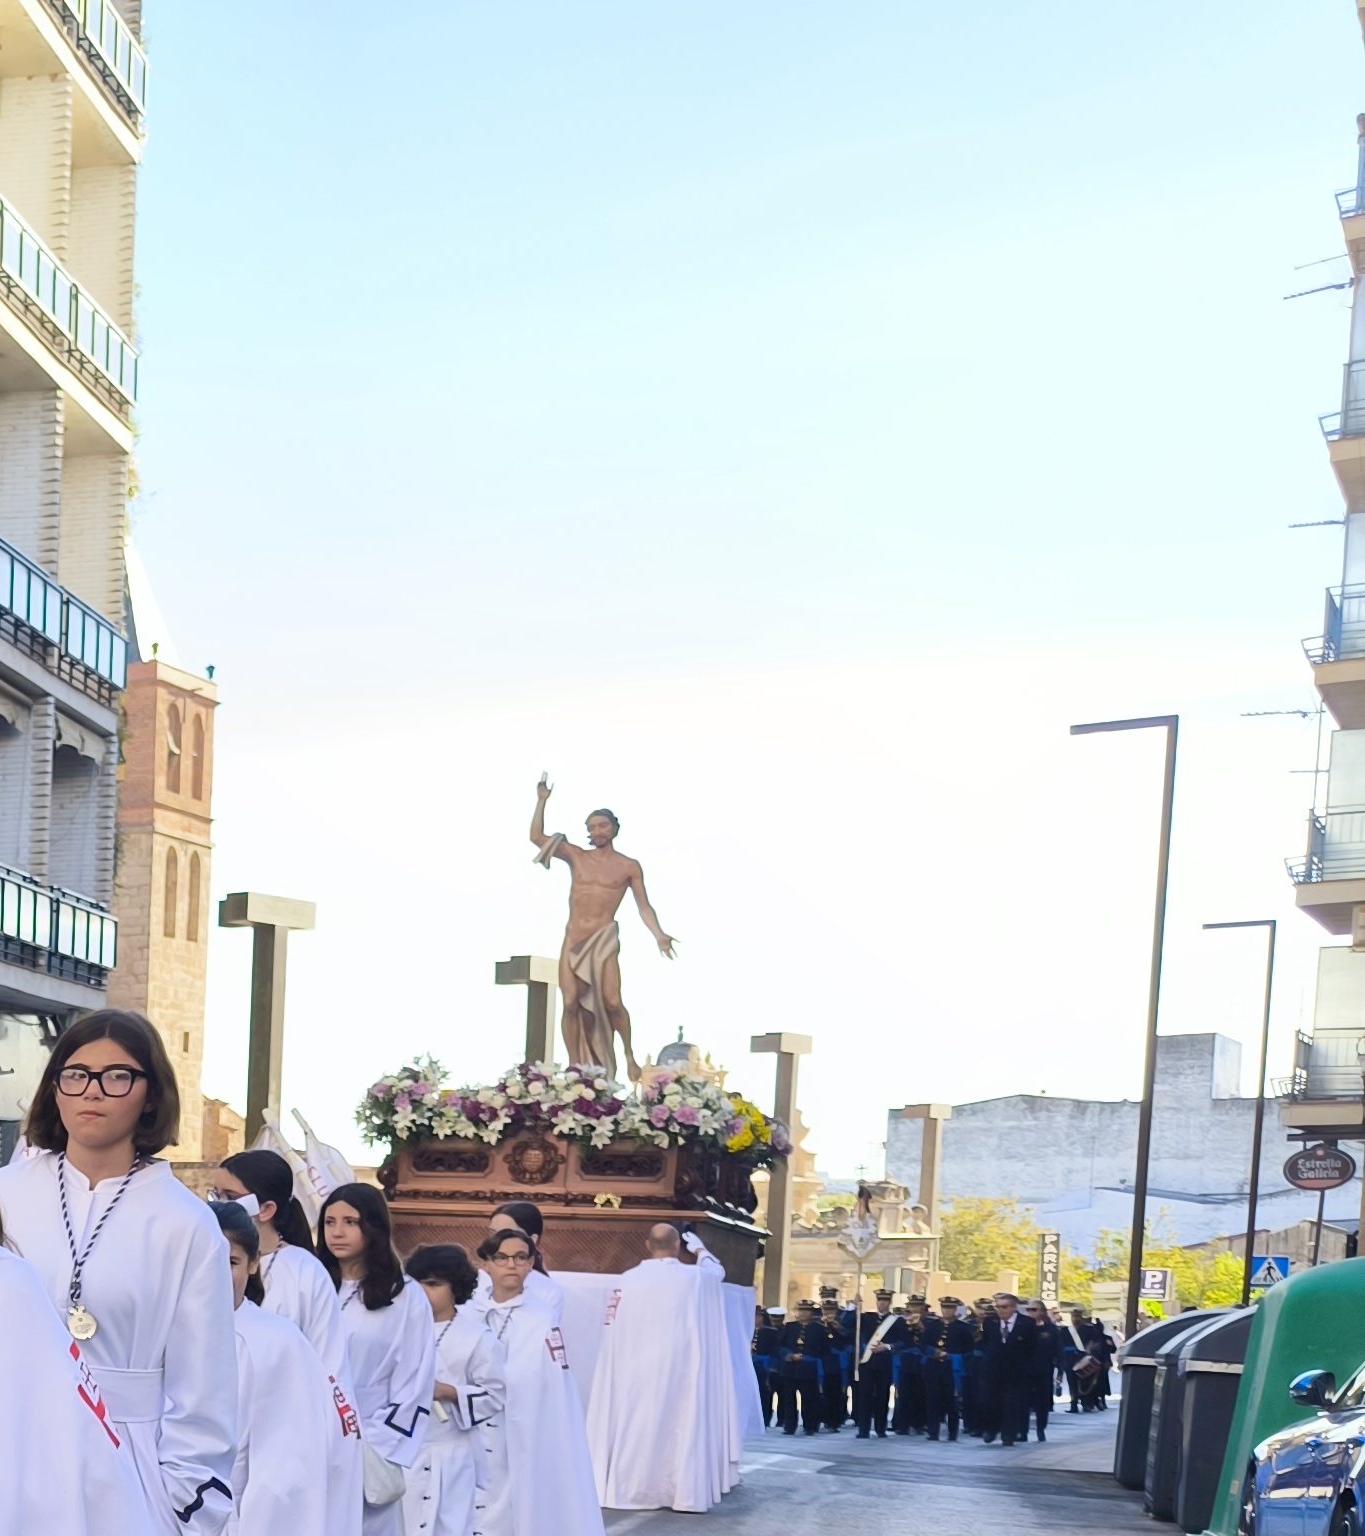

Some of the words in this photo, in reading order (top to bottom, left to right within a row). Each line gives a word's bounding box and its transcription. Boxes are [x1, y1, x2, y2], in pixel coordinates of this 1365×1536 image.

[1297, 1158, 1342, 1169] Estrella
[1297, 1168, 1340, 1179] Galicia
[1041, 1234, 1058, 1300] PARKING
[1144, 1270, 1163, 1289] P
